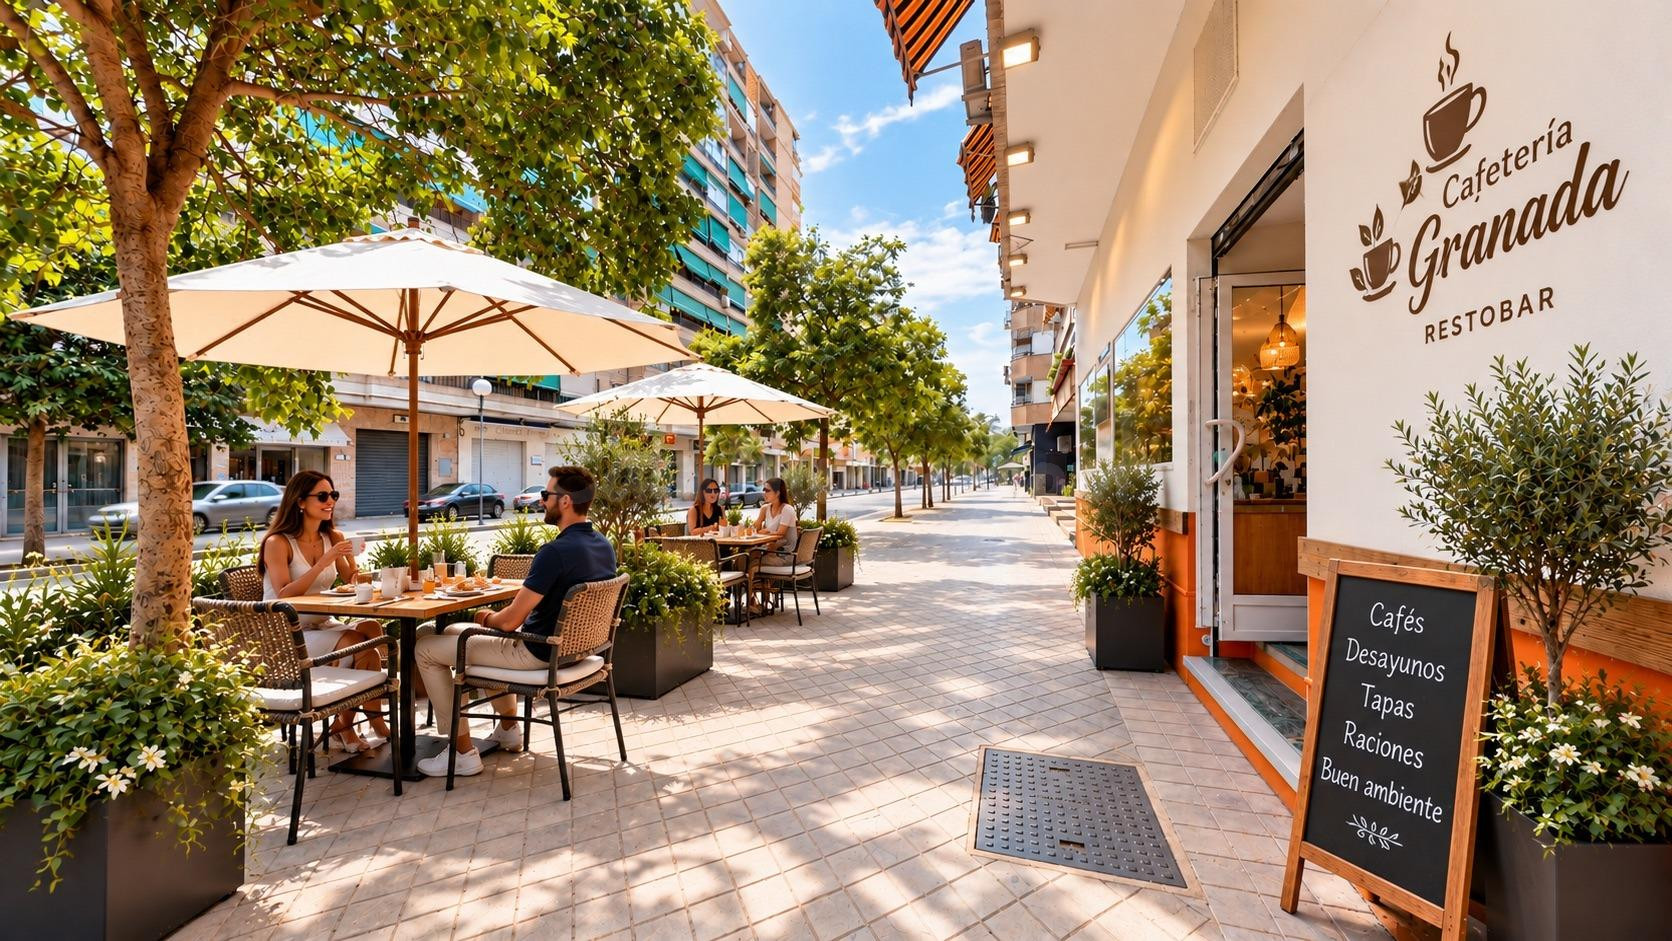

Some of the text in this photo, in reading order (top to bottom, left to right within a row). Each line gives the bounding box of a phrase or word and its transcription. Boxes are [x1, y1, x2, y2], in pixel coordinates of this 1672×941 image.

[1443, 118, 1573, 208] Cafetería
[1408, 141, 1630, 315] Granada
[1425, 287, 1554, 344] RESTOBAR
[1370, 602, 1425, 635] Cafés
[1346, 638, 1446, 682] Desayunos
[1361, 683, 1415, 719] Tapas
[1344, 721, 1424, 769] Raciones
[1320, 756, 1443, 824] Buen ambiente
